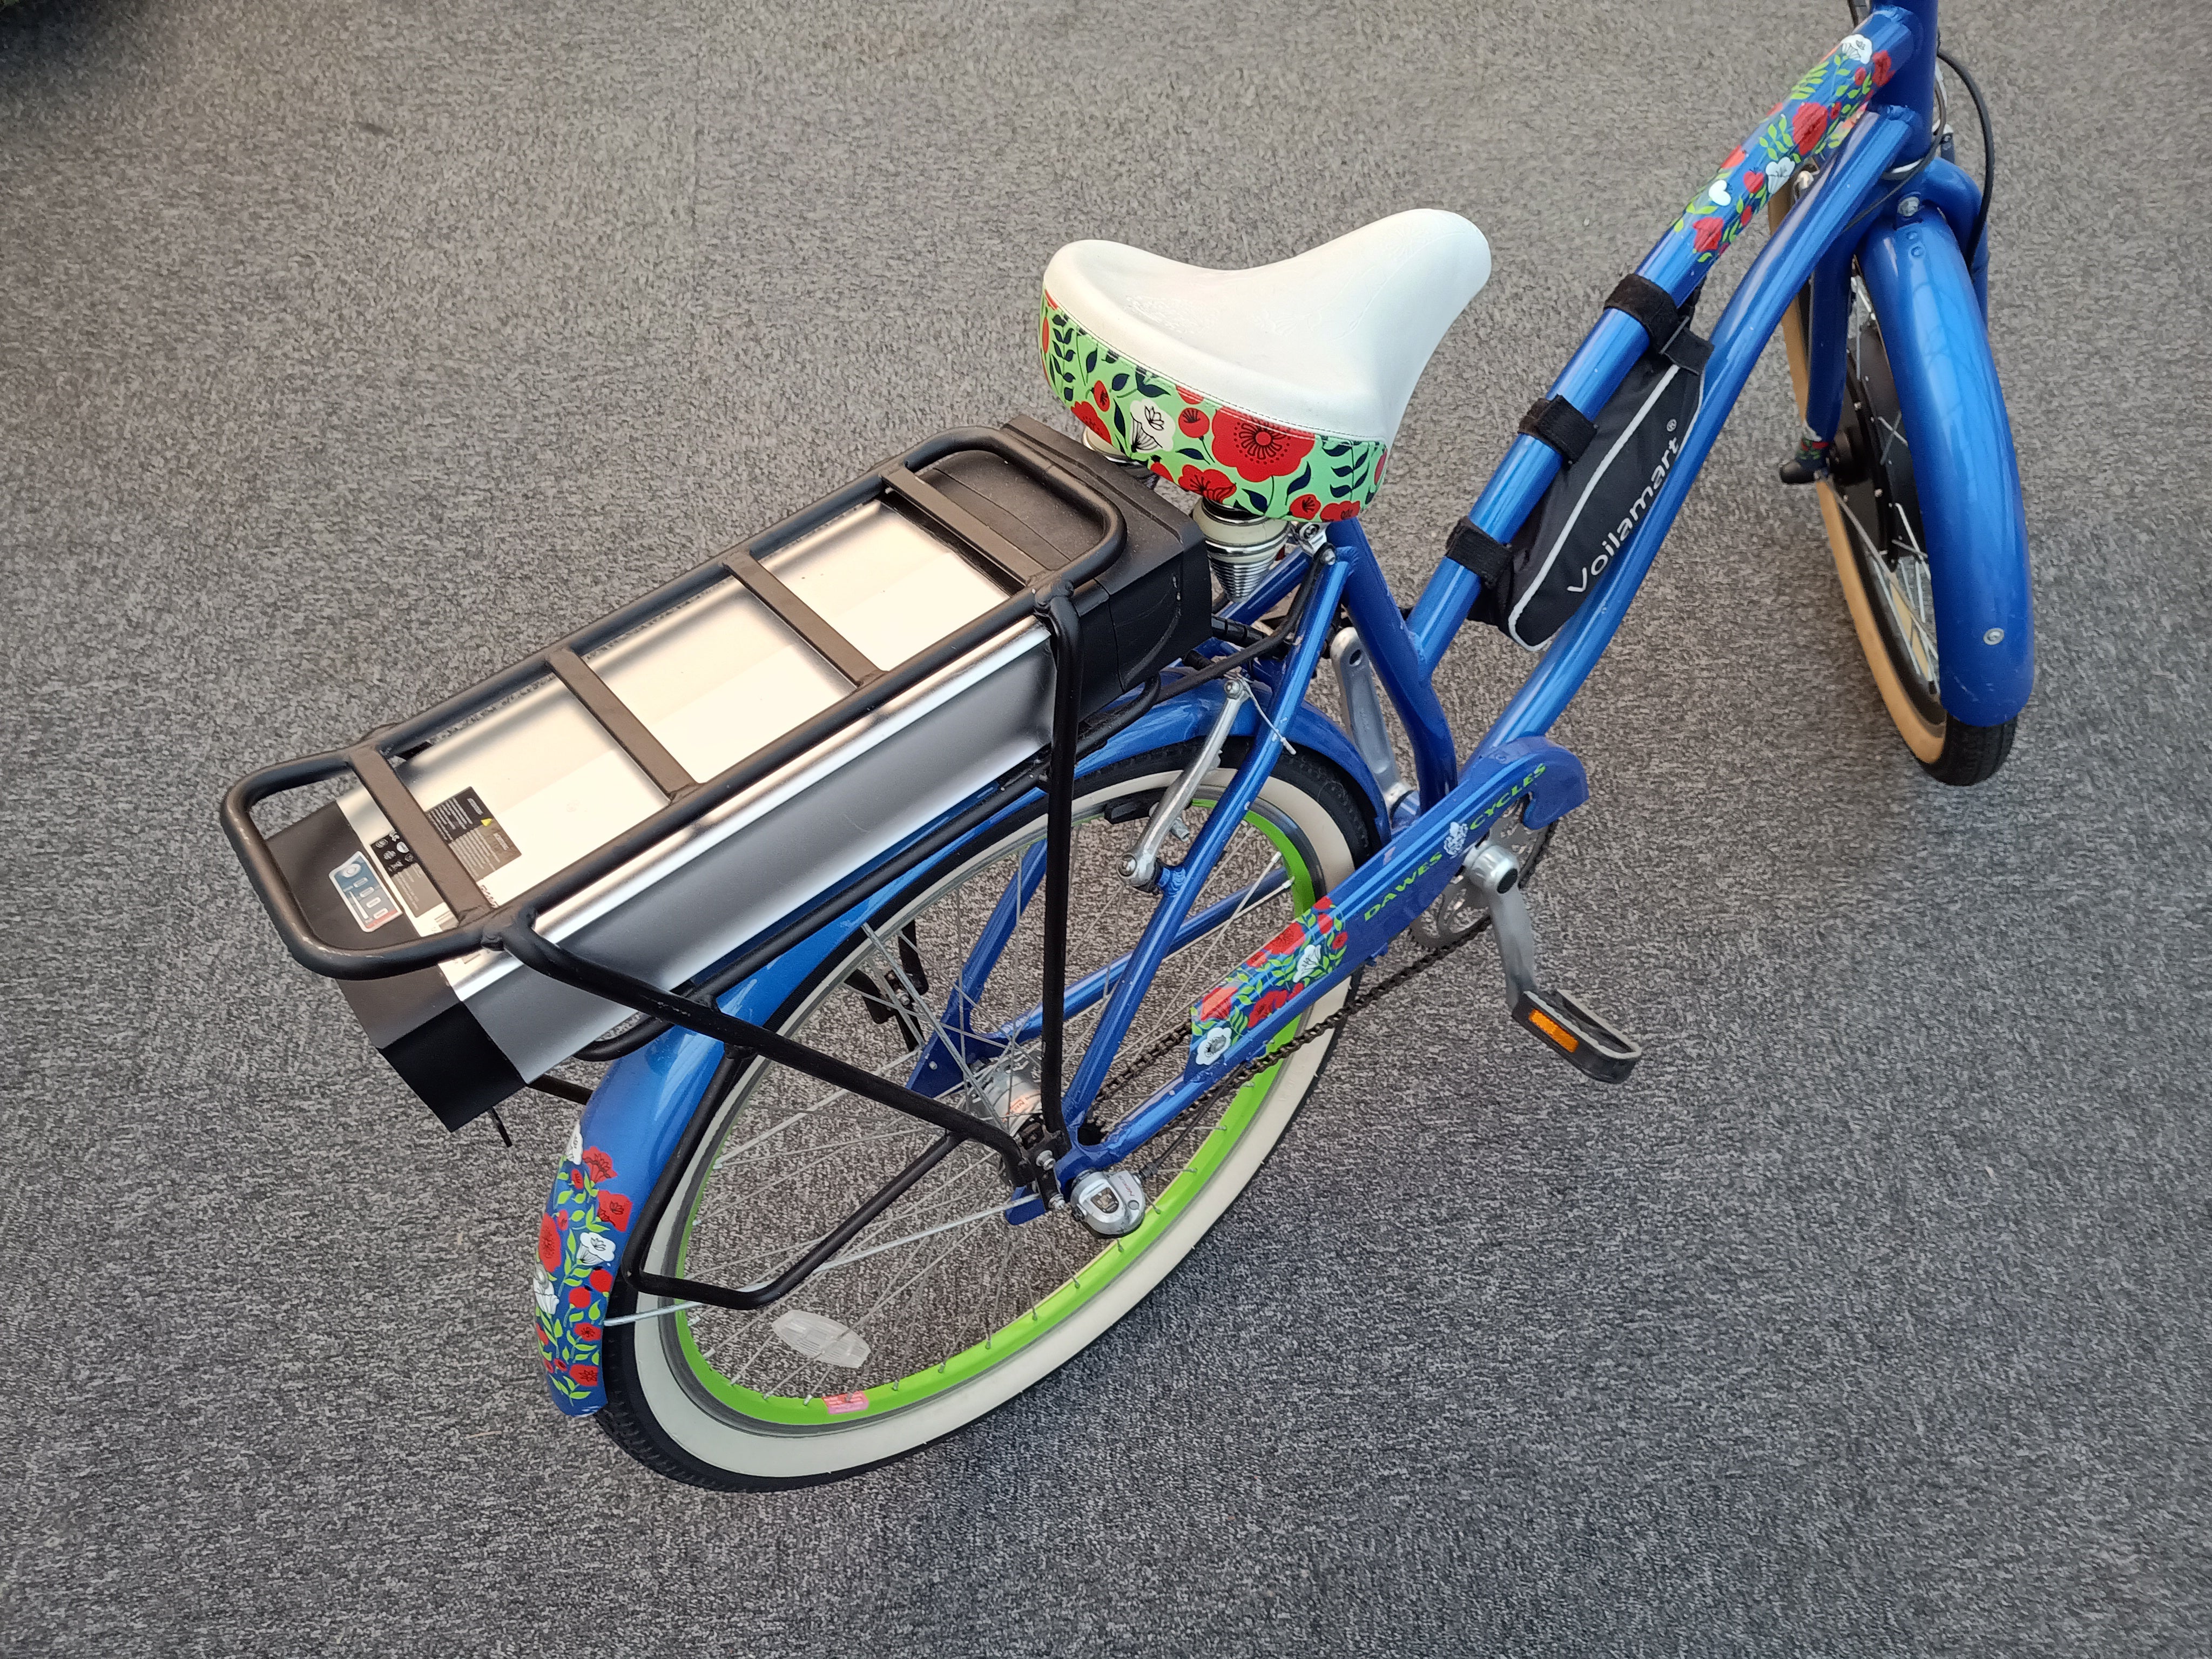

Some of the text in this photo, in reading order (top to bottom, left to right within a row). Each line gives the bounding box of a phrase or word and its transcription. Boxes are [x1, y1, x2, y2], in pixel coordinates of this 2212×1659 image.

[1567, 436, 1680, 593] Voilamart
[1364, 763, 1546, 921] DAWES CYCLES
